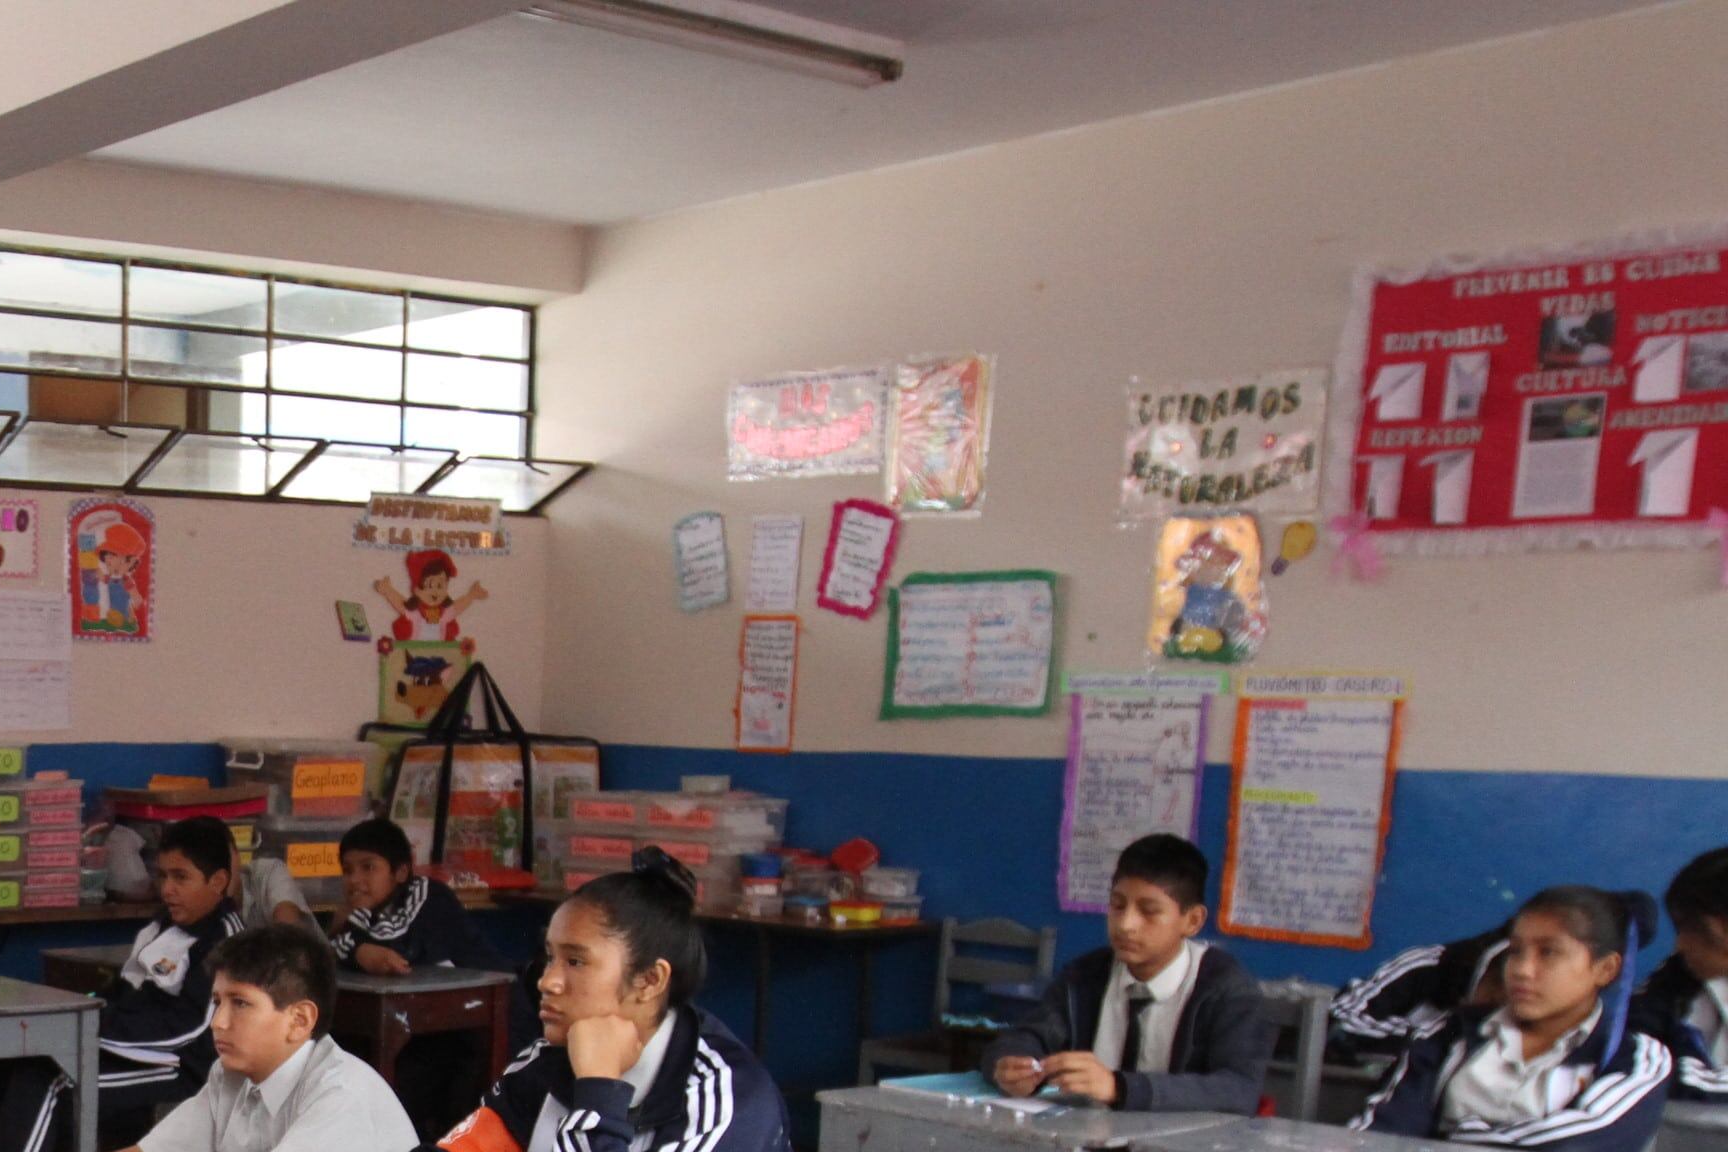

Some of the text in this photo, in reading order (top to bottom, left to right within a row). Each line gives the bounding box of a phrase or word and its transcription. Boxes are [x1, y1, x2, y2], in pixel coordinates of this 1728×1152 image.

[1138, 381, 1302, 425] CUIDAMOS
[1199, 426, 1239, 460] LA
[1132, 440, 1315, 504] NATURALEZA
[388, 526, 413, 546] LA
[423, 528, 506, 548] LECTURA
[295, 767, 358, 788] Geoplano
[290, 845, 339, 872] Geopla
